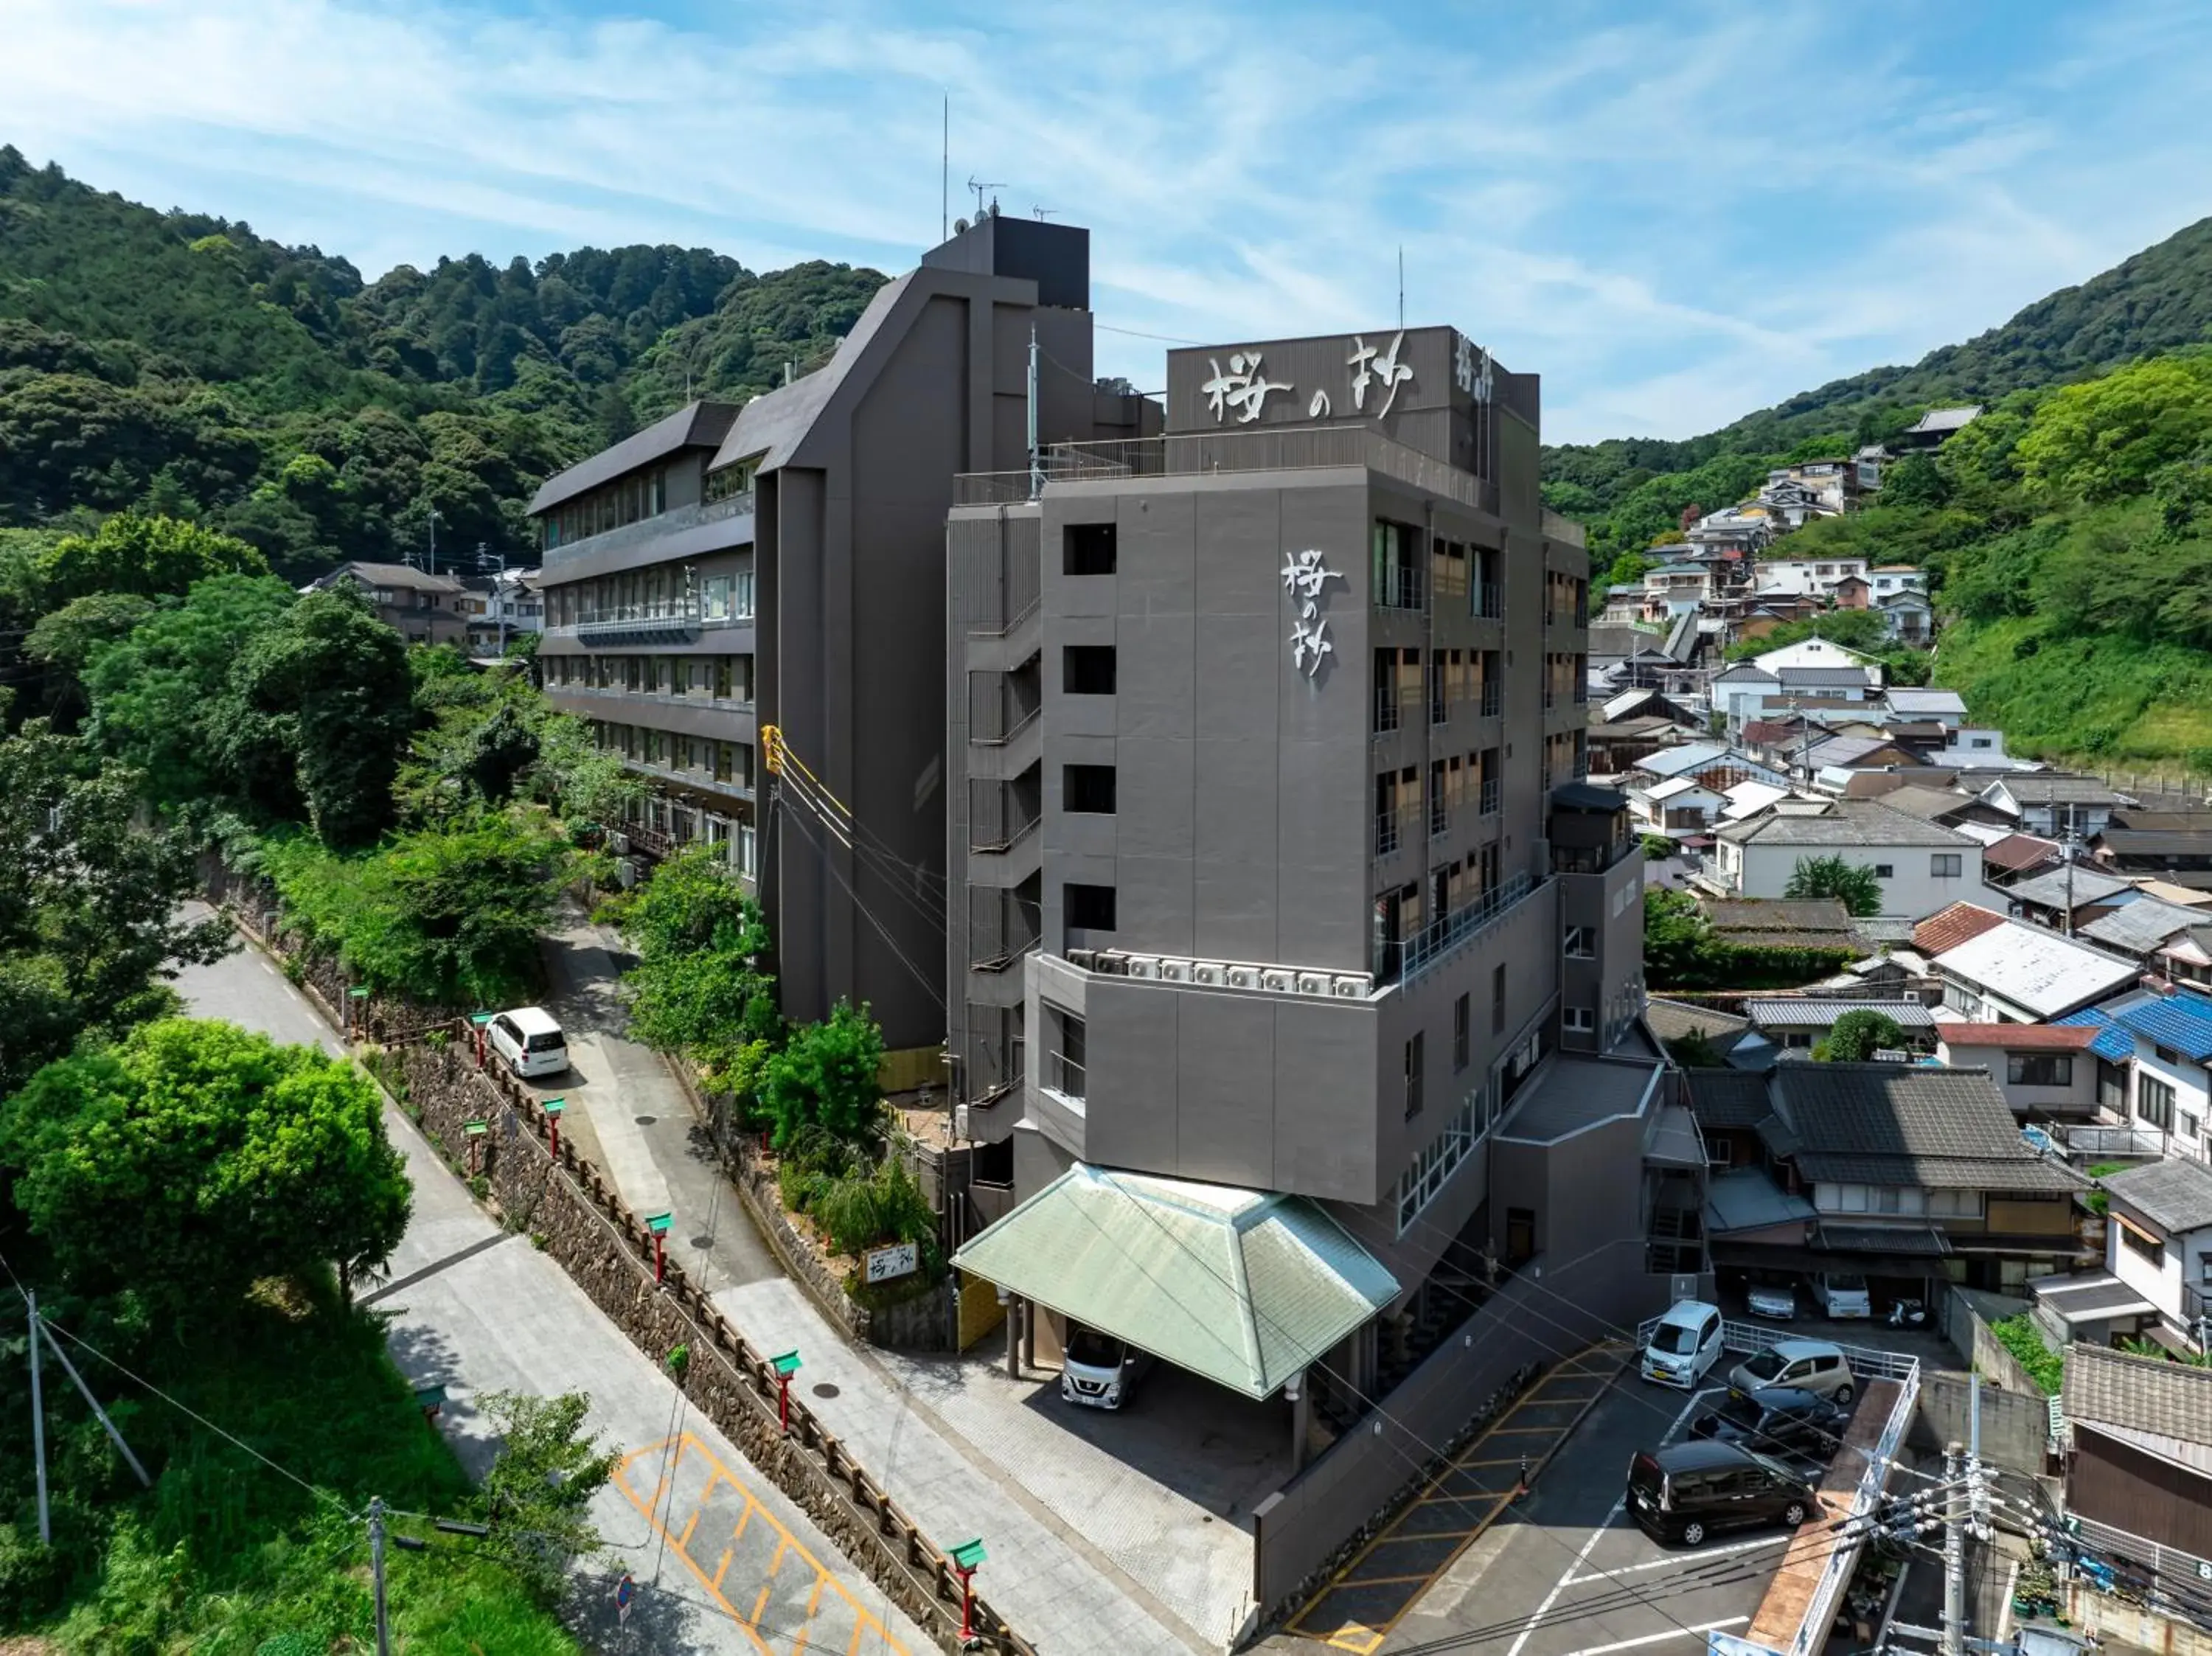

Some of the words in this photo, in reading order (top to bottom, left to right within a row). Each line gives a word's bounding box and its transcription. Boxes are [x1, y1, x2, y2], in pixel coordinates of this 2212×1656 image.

[1201, 331, 1413, 423] 桜の抄
[1281, 550, 1343, 677] 桜の抄
[2066, 1517, 2078, 1531] 7
[2199, 1563, 2212, 1580] 8
